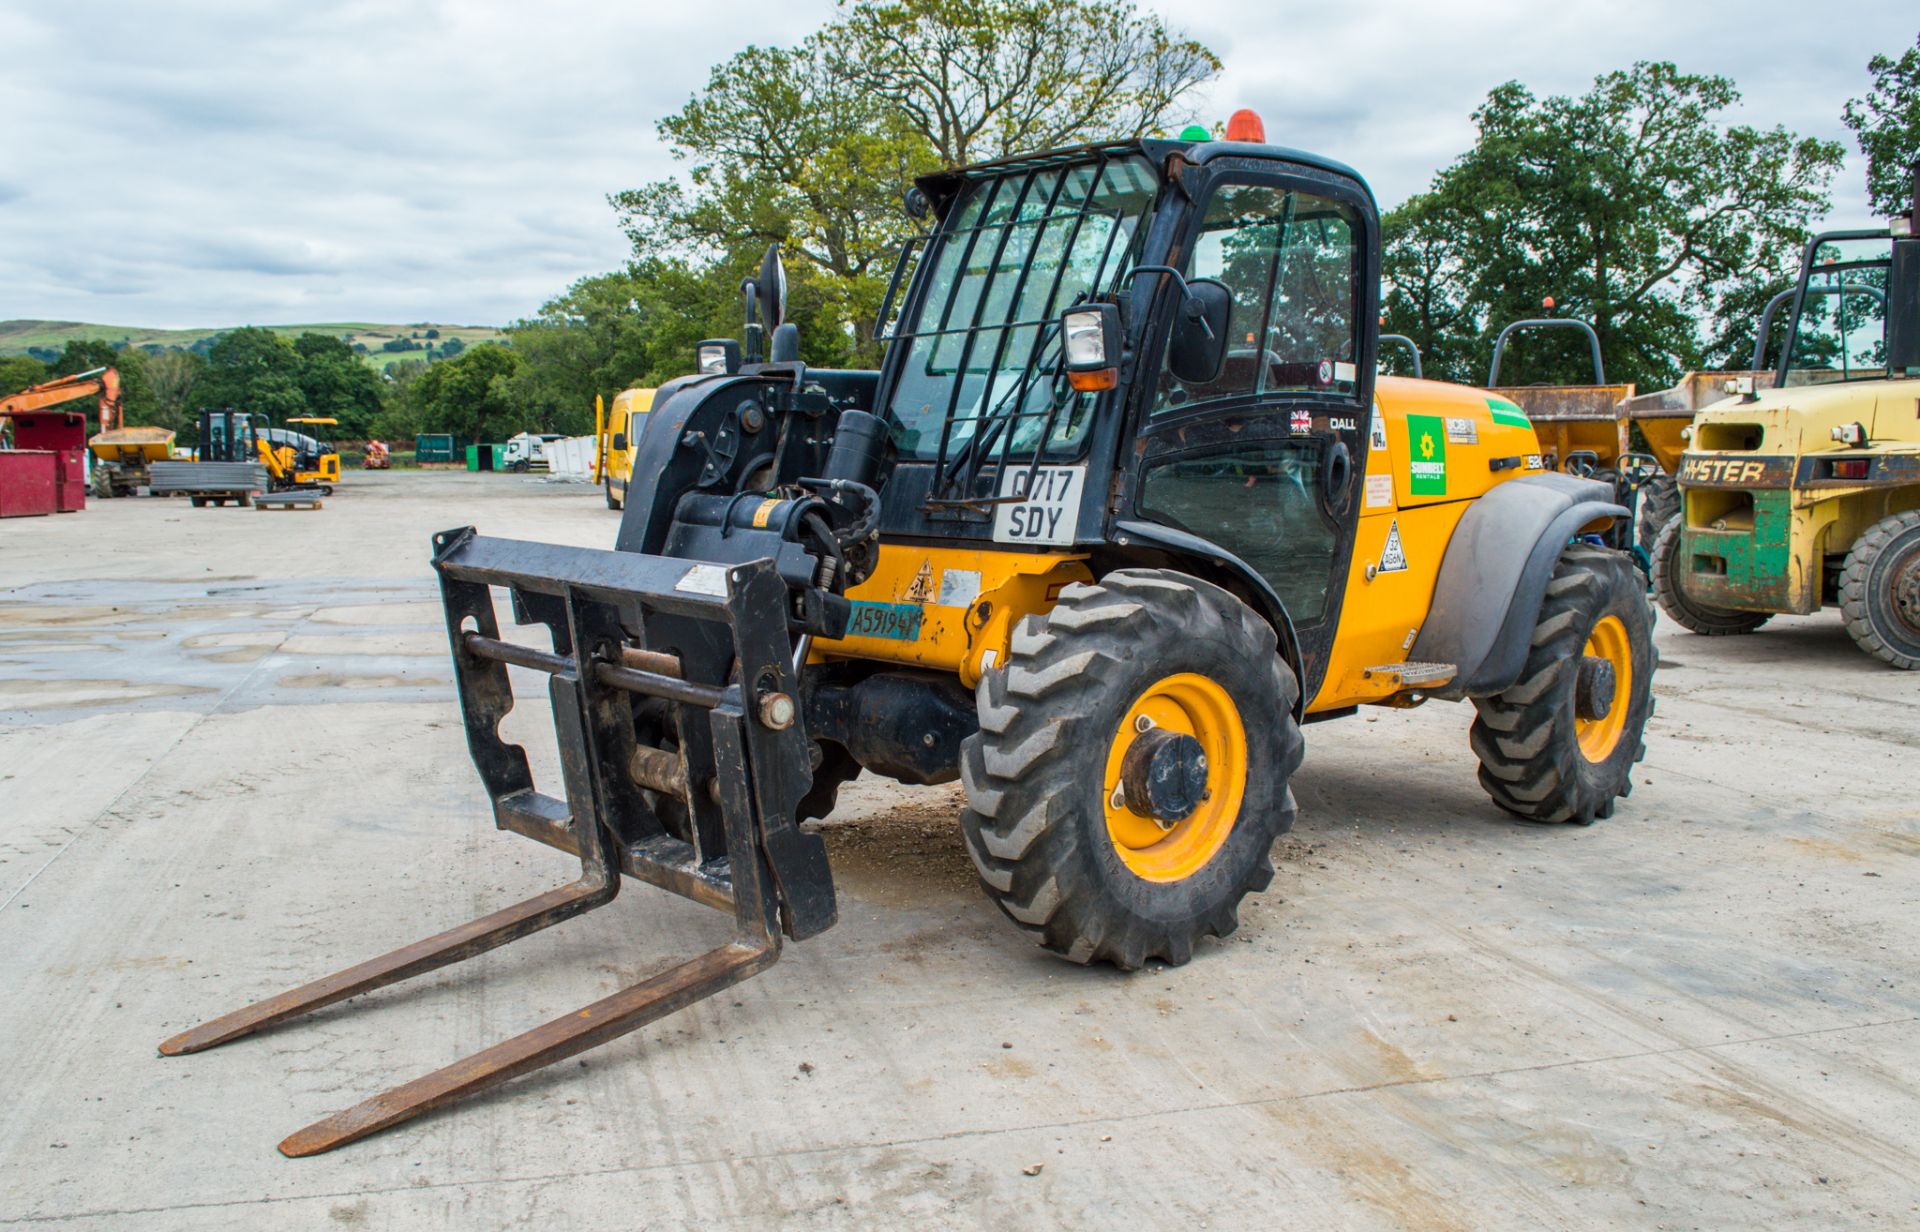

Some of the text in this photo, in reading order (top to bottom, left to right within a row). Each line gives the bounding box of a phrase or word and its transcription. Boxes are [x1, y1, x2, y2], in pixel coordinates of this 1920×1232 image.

[1411, 461, 1445, 474] SUNBELT
[1683, 459, 1766, 482] HYSTER
[1008, 506, 1063, 538] SDY
